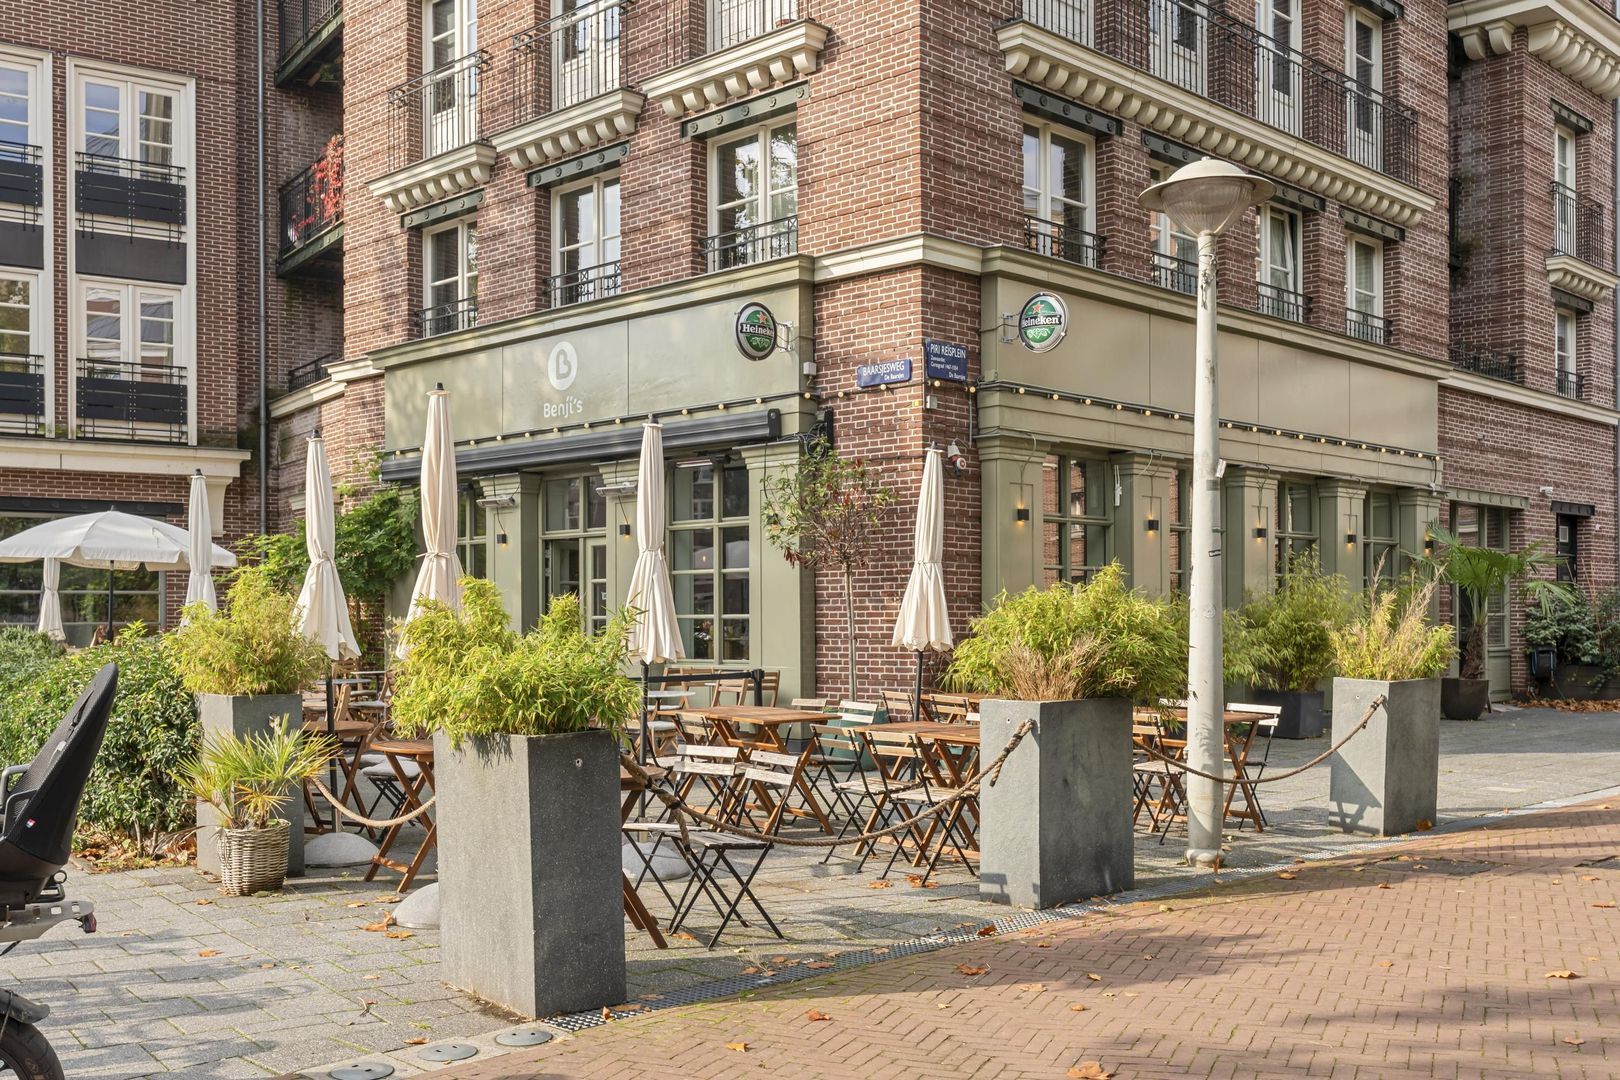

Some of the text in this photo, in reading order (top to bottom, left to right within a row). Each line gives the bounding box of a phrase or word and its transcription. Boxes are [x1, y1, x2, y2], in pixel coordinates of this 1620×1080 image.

[1023, 316, 1059, 326] eineken
[930, 344, 940, 354] PIRI
[862, 361, 904, 376] BAARSJESWEG
[543, 395, 583, 418] Benji's
